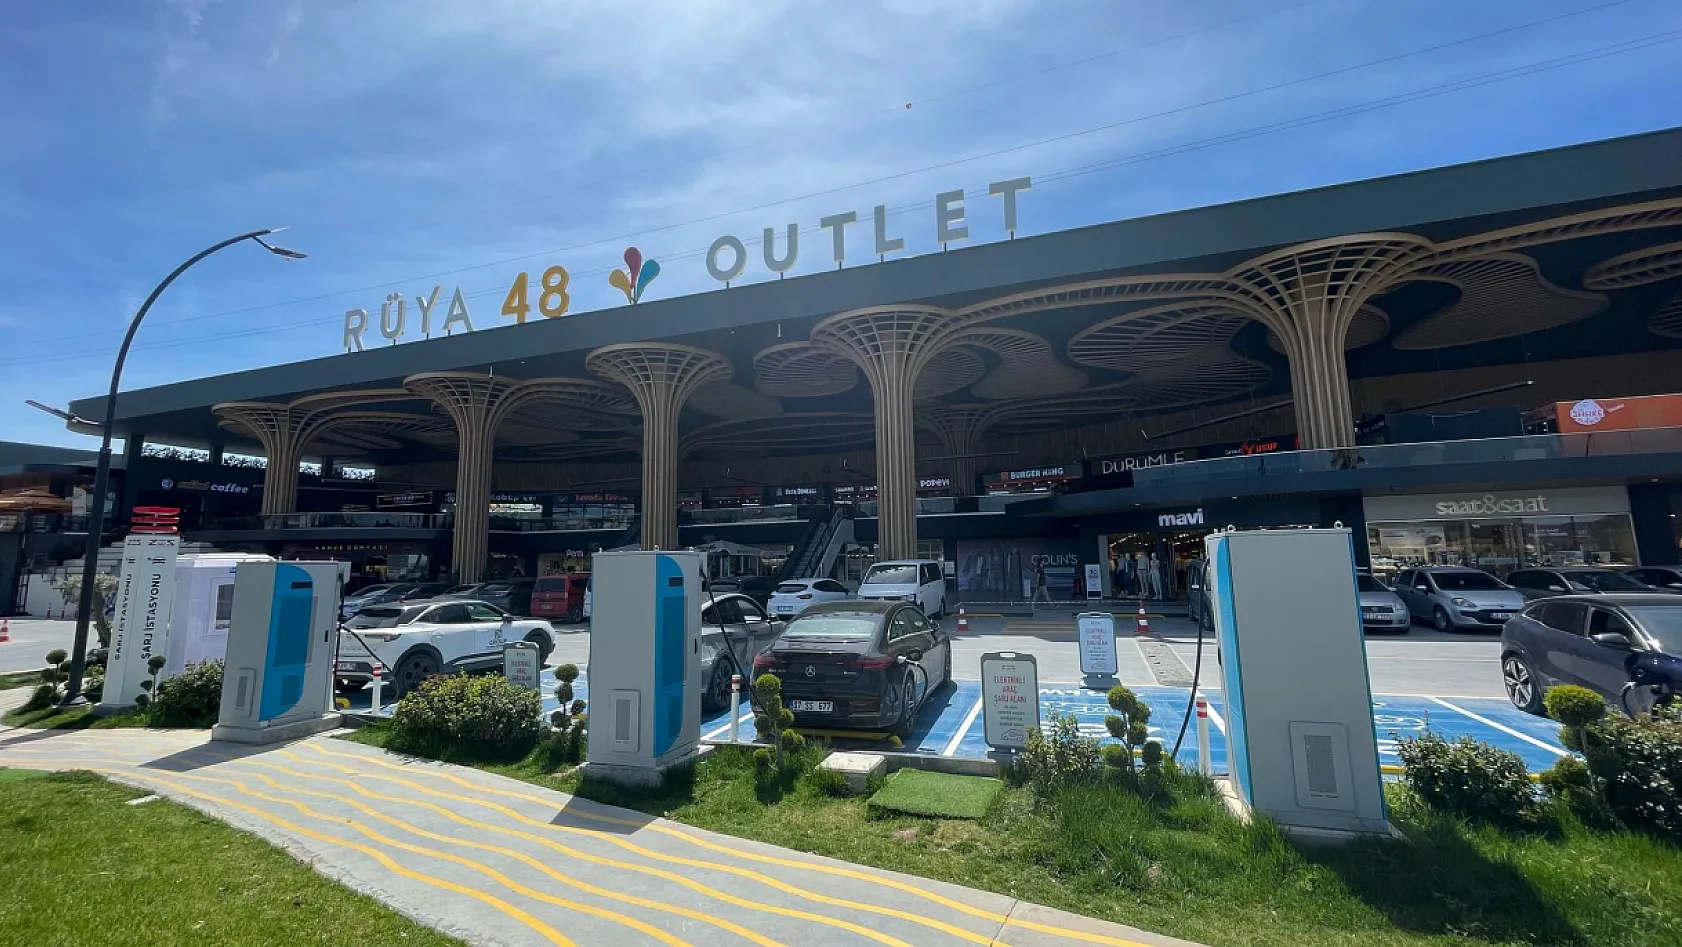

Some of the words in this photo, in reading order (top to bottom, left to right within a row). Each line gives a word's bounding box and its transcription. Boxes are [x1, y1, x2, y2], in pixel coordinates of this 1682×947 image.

[343, 285, 474, 351] RÜYA
[501, 265, 570, 324] 48
[706, 177, 1031, 281] OUTLET
[1010, 470, 1041, 480] BURGER
[1042, 467, 1064, 477] KING
[1102, 451, 1184, 474] DÜRÜMLE
[210, 482, 249, 494] coffee
[1436, 494, 1549, 516] saat&saat
[1158, 508, 1204, 527] mavi
[1031, 553, 1078, 566] COLIN'S
[145, 573, 162, 632] İSTASYONU
[141, 632, 153, 661] ŞARJ
